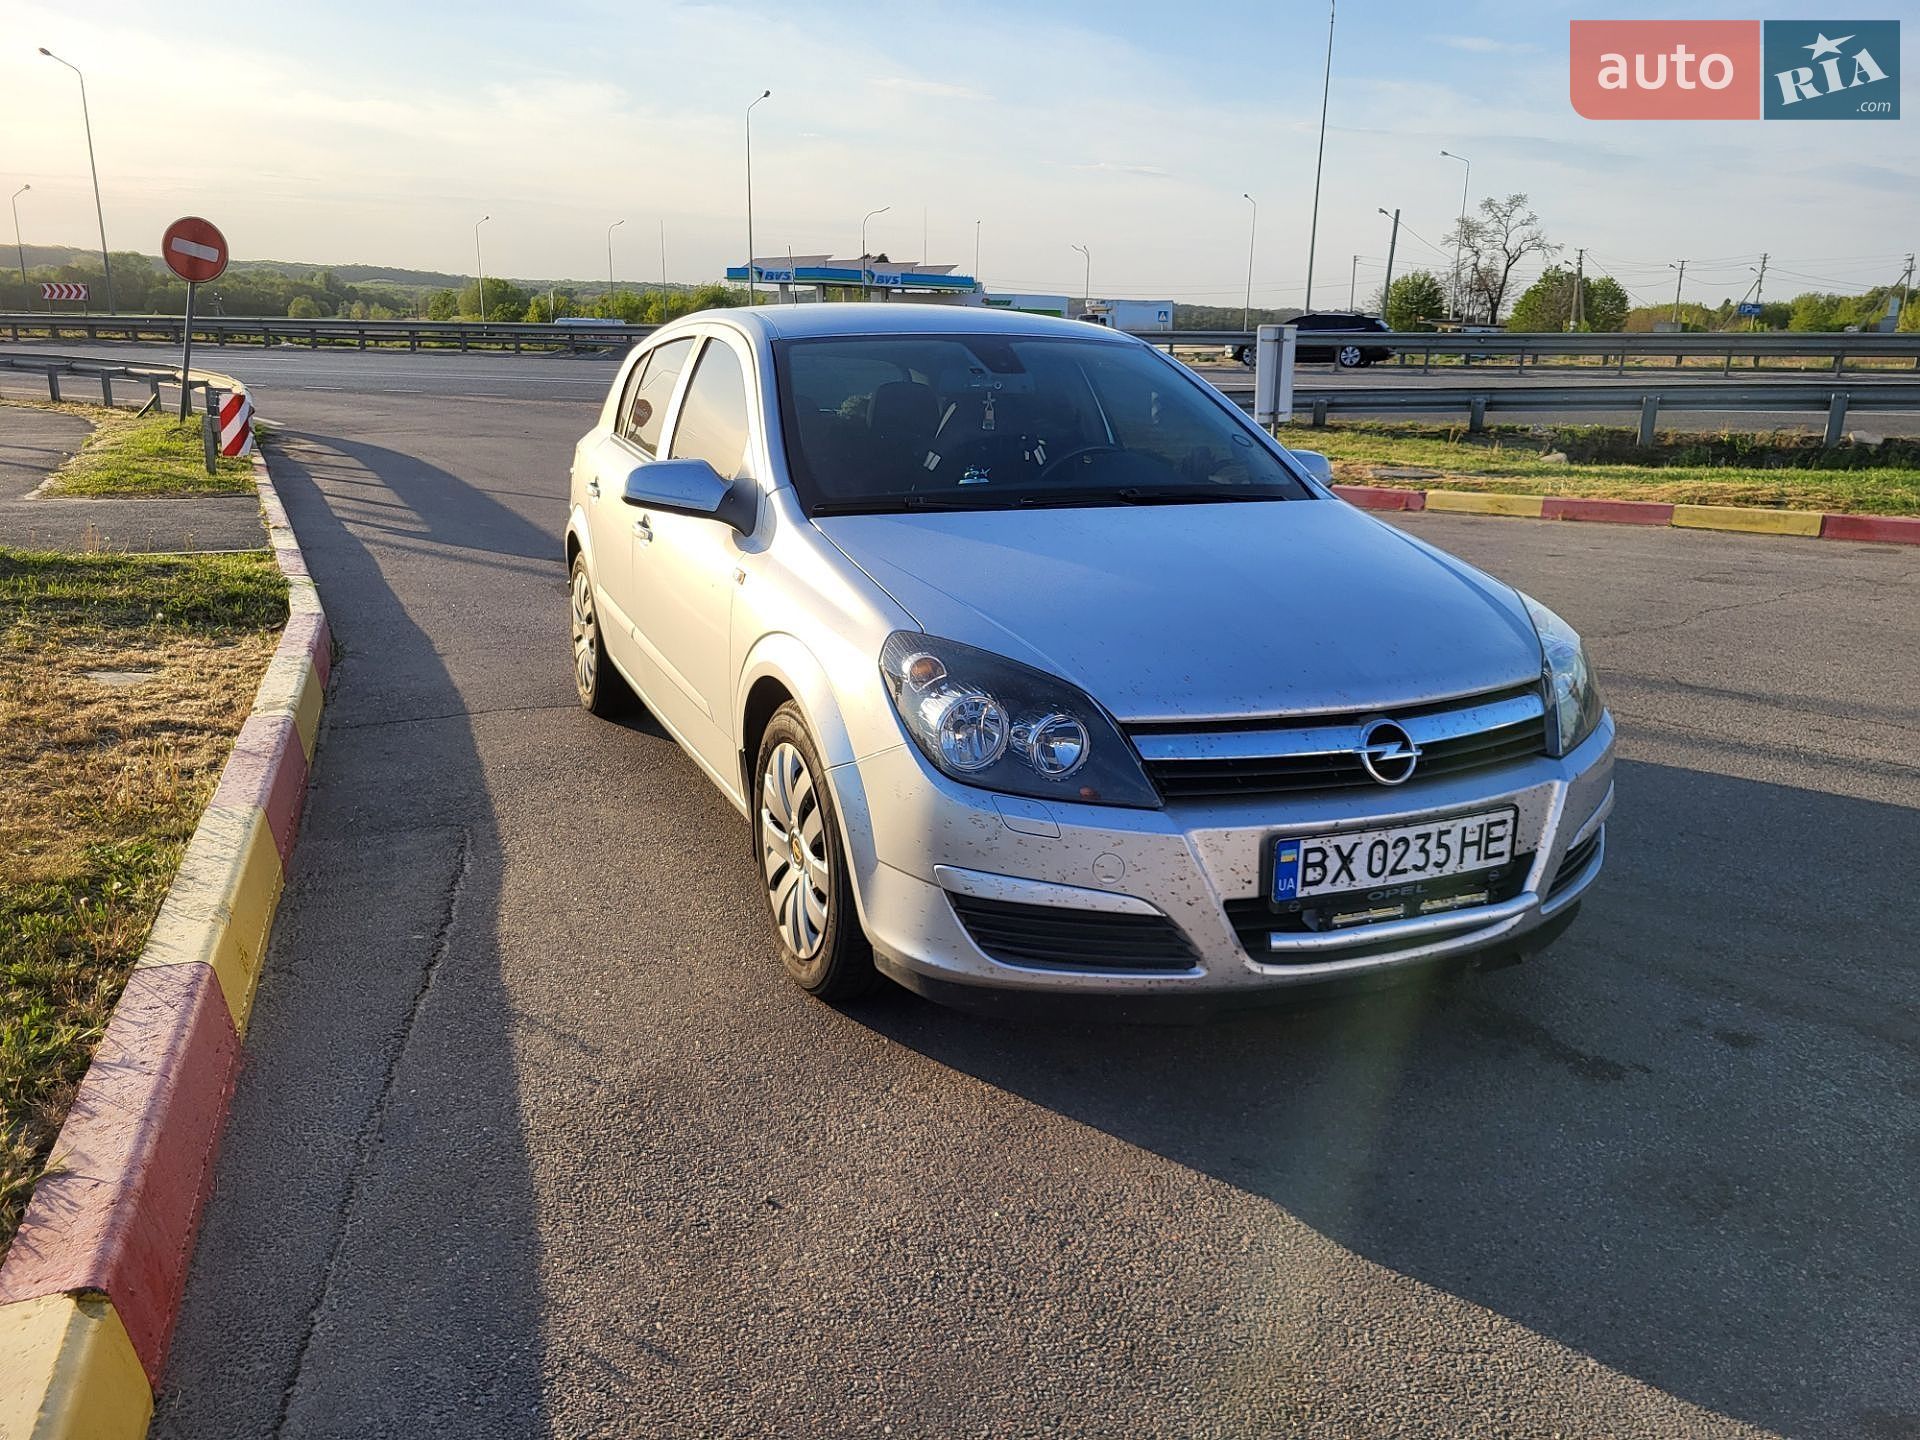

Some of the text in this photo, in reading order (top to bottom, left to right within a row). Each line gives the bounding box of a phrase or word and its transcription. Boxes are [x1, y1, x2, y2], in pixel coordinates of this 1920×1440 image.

[764, 271, 792, 281] BVS
[875, 274, 900, 285] BVS
[1301, 819, 1508, 888] BX 0235 HE
[1278, 877, 1296, 892] UA
[1367, 884, 1429, 901] OPEL
